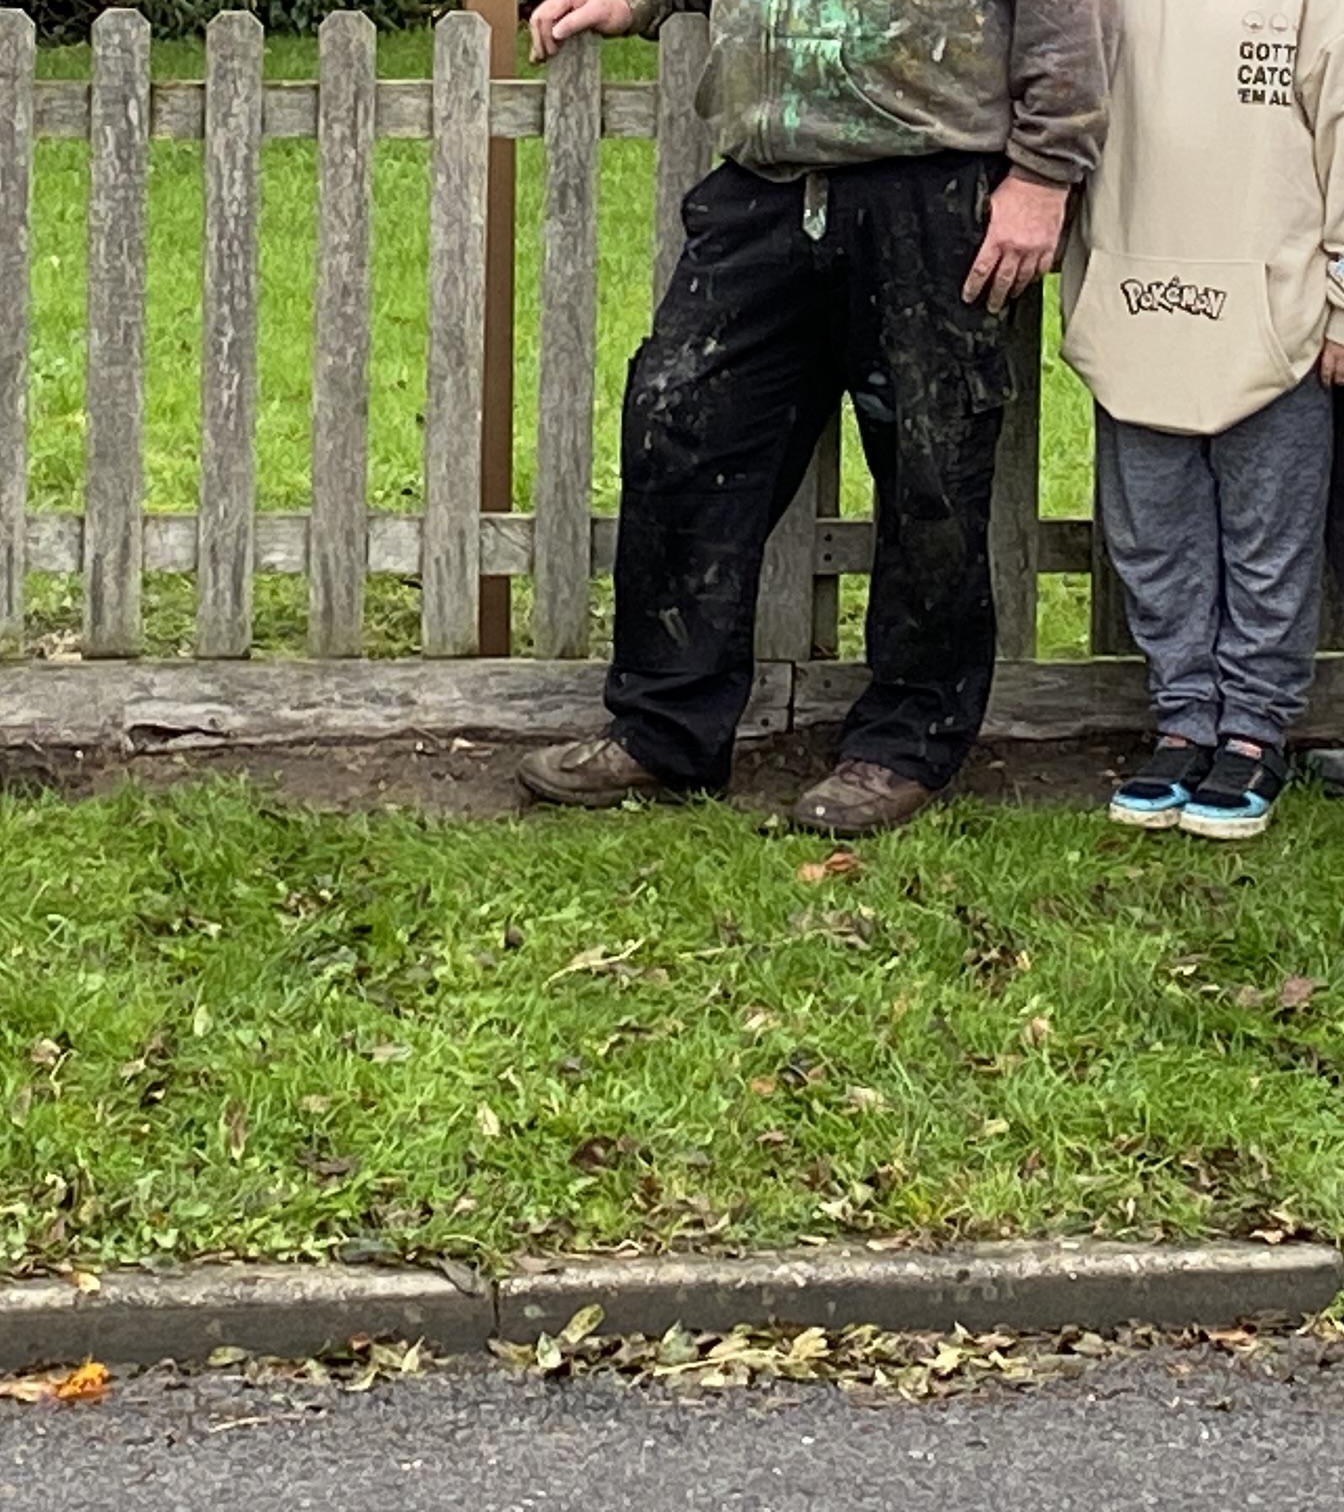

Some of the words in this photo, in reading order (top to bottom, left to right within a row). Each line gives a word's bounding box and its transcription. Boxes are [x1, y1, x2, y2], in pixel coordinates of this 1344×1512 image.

[1239, 41, 1297, 63] GOTT
[1237, 64, 1293, 86] CATC
[1269, 90, 1293, 106] AL
